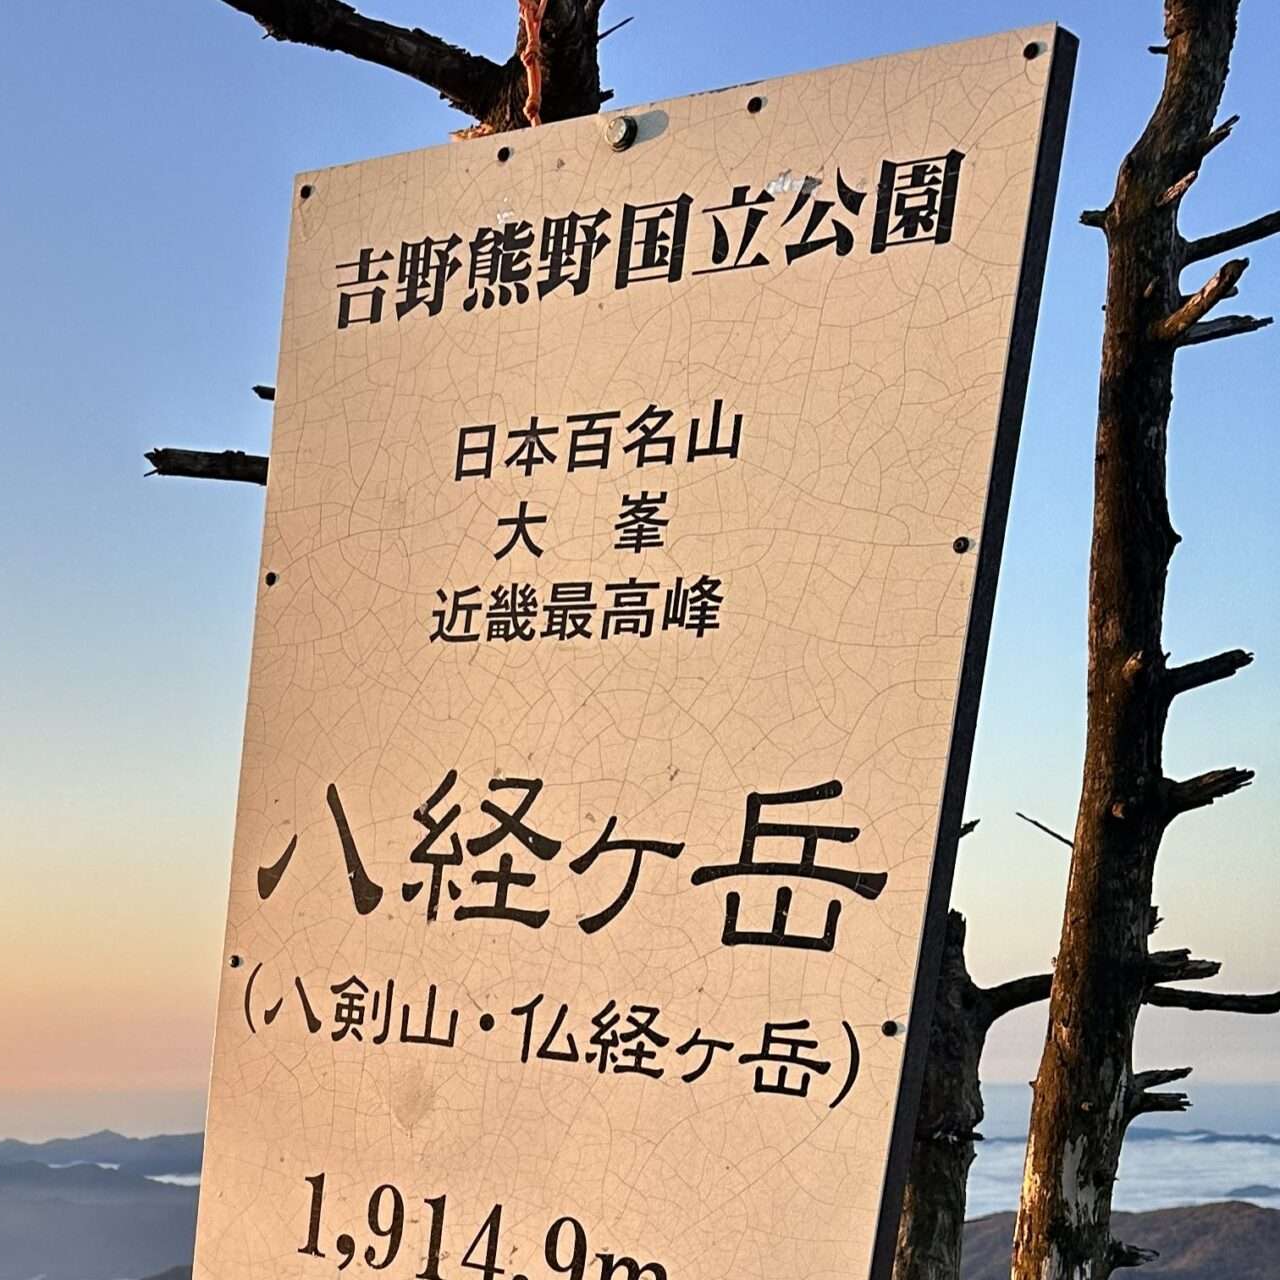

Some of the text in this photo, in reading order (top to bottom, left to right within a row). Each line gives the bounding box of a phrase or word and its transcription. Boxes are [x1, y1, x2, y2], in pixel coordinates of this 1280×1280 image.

[334, 148, 966, 330] 吉野熊野国立公園
[454, 399, 743, 482] 日本百名山
[429, 574, 724, 644] 近畿最高峰
